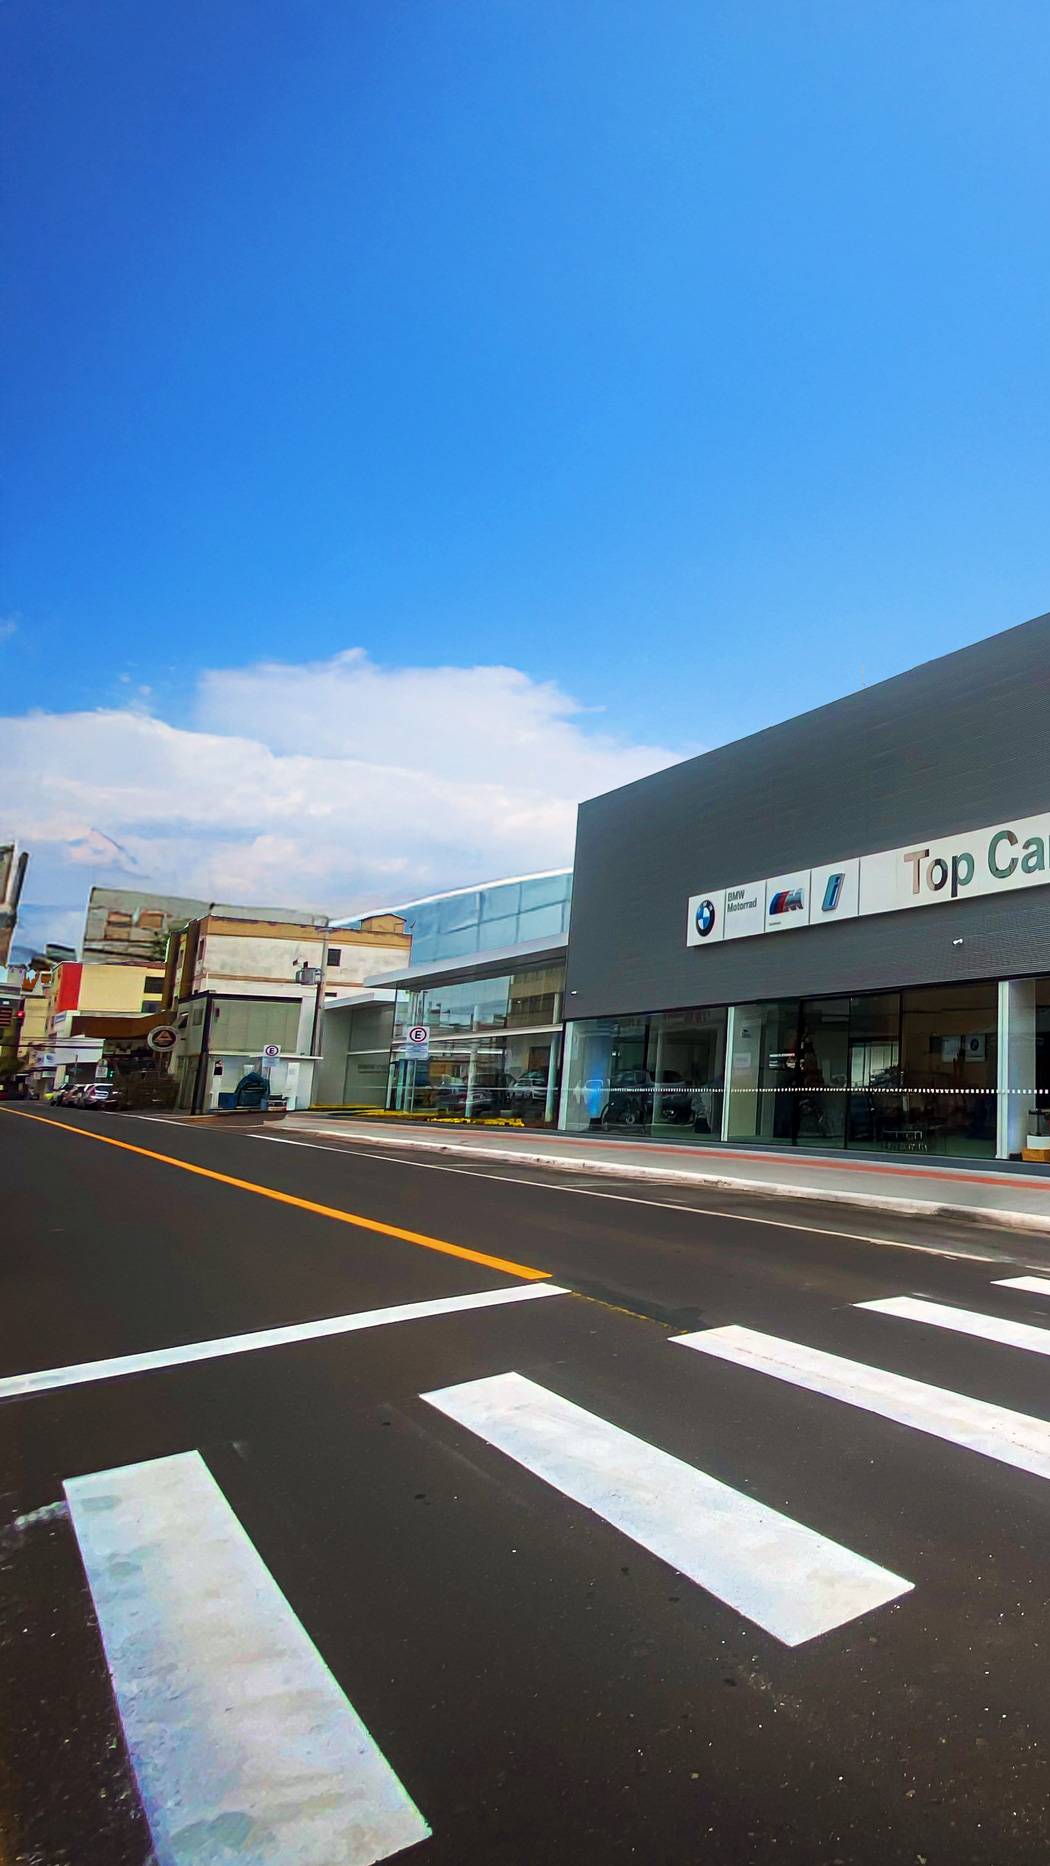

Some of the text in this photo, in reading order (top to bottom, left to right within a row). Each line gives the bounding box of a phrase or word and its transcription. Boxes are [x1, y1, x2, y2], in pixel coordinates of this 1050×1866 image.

[904, 849, 975, 898] Top
[728, 889, 745, 902] BMW
[727, 897, 757, 913] Motorrad
[414, 1030, 422, 1039] E
